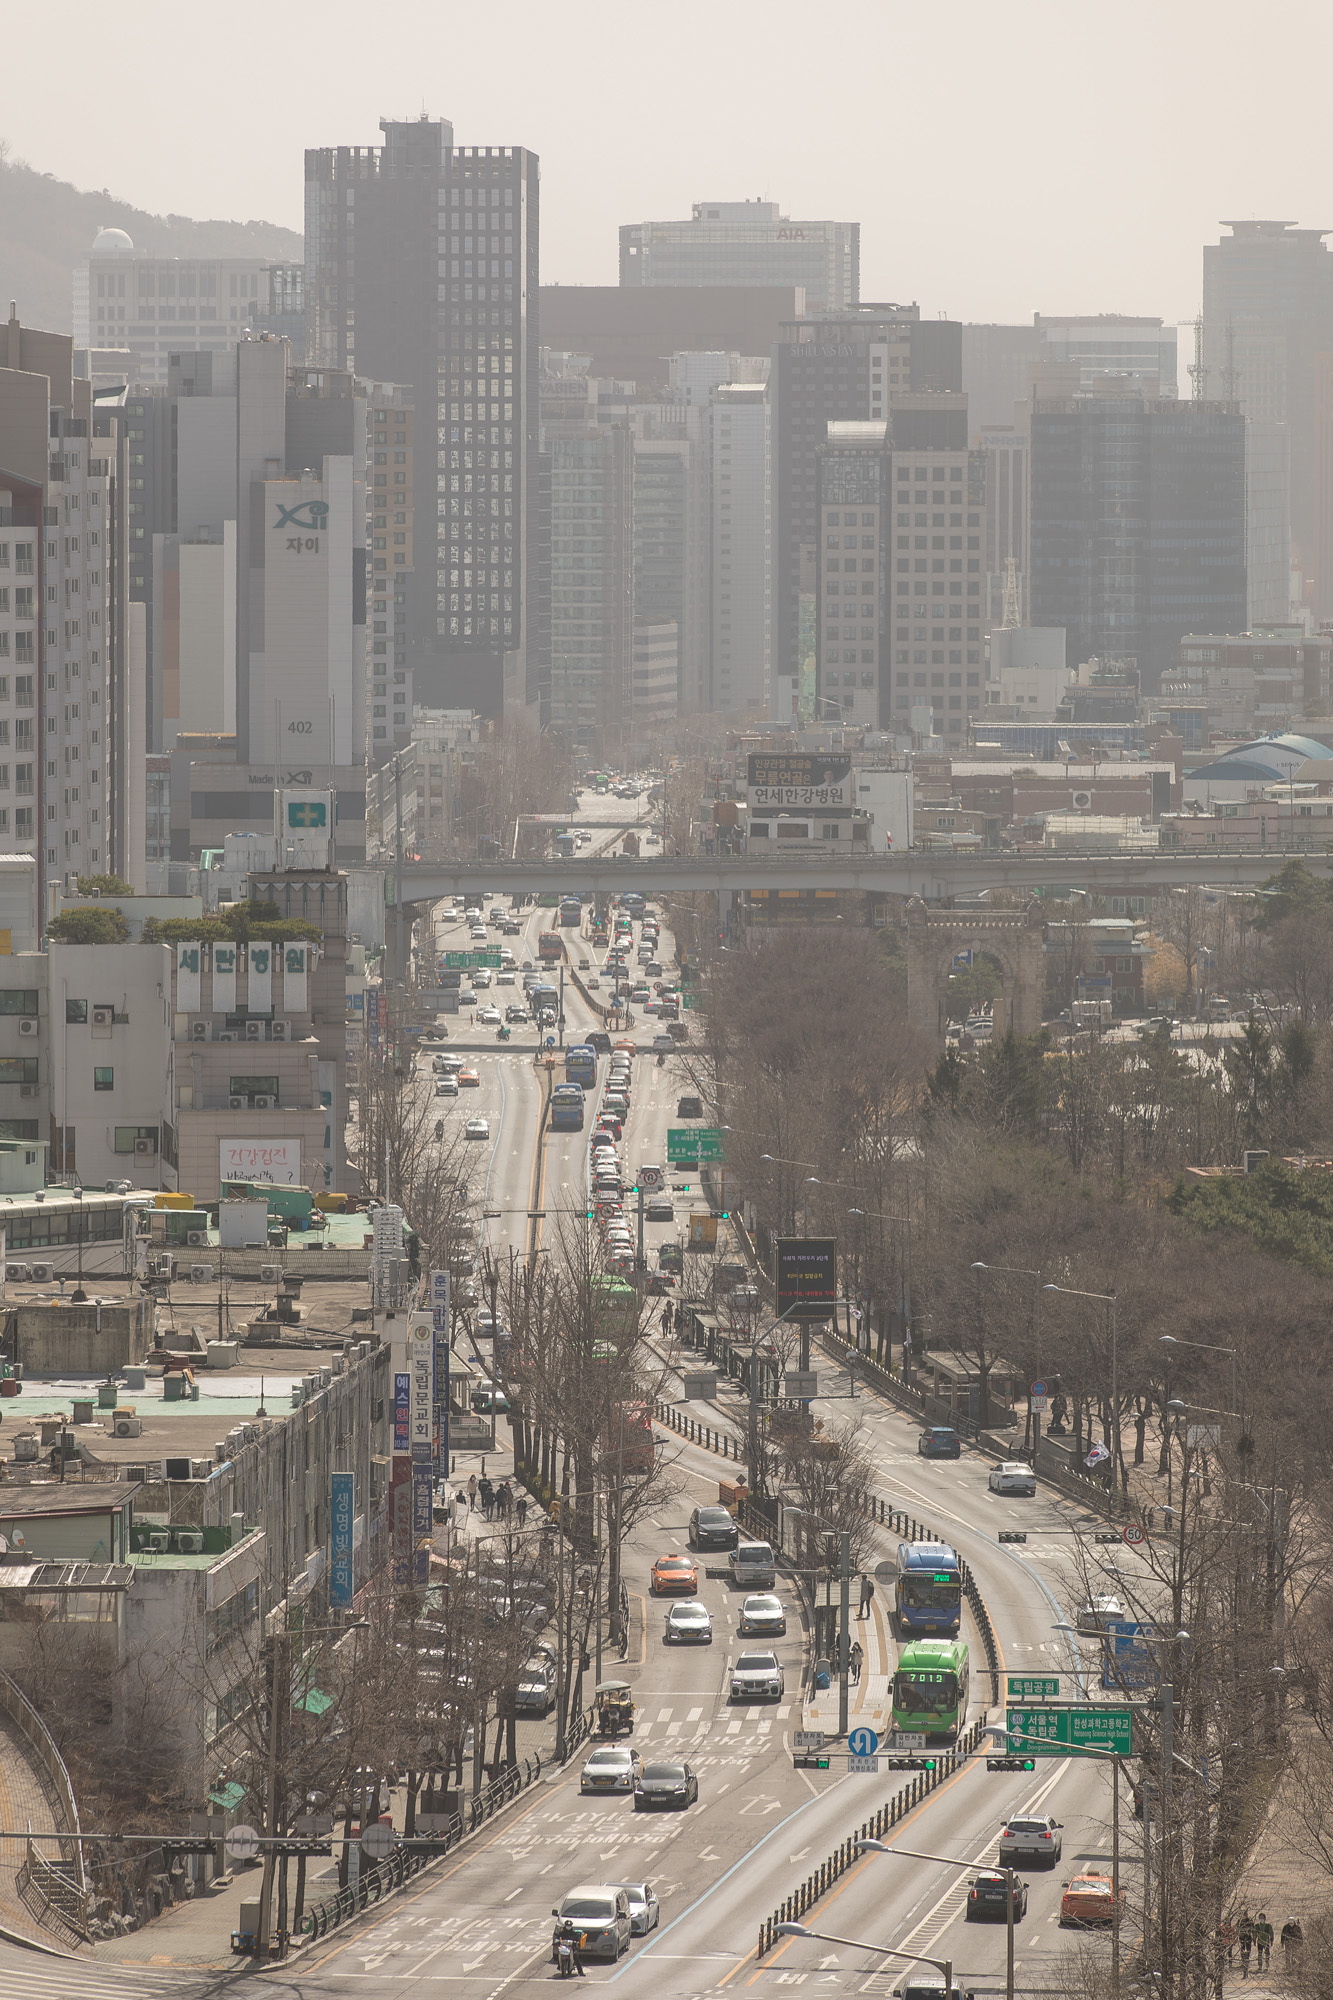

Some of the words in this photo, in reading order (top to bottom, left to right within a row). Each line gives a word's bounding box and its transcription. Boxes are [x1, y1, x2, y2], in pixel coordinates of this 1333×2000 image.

[777, 228, 806, 240] AIA
[791, 345, 828, 356] SHILLA
[831, 345, 856, 356] STAY
[286, 536, 320, 554] 자이
[287, 722, 313, 736] 402
[248, 773, 273, 785] Made
[755, 787, 843, 804] 연세한강병원
[179, 948, 305, 974] 세란병원
[227, 1147, 289, 1166] 건강검진
[415, 1359, 430, 1438] 독립문교회
[336, 1492, 349, 1588] 생명빛교회
[1127, 1528, 1141, 1540] 50
[1012, 1681, 1055, 1694] 독립공원
[1027, 1714, 1058, 1726] 서울역
[1073, 1718, 1129, 1730] 한성과학고등학교
[796, 1732, 823, 1740] 중앙차로
[898, 1734, 924, 1742] 일반차로
[1027, 1726, 1058, 1738] 독립문
[776, 1972, 843, 1987] 버스
